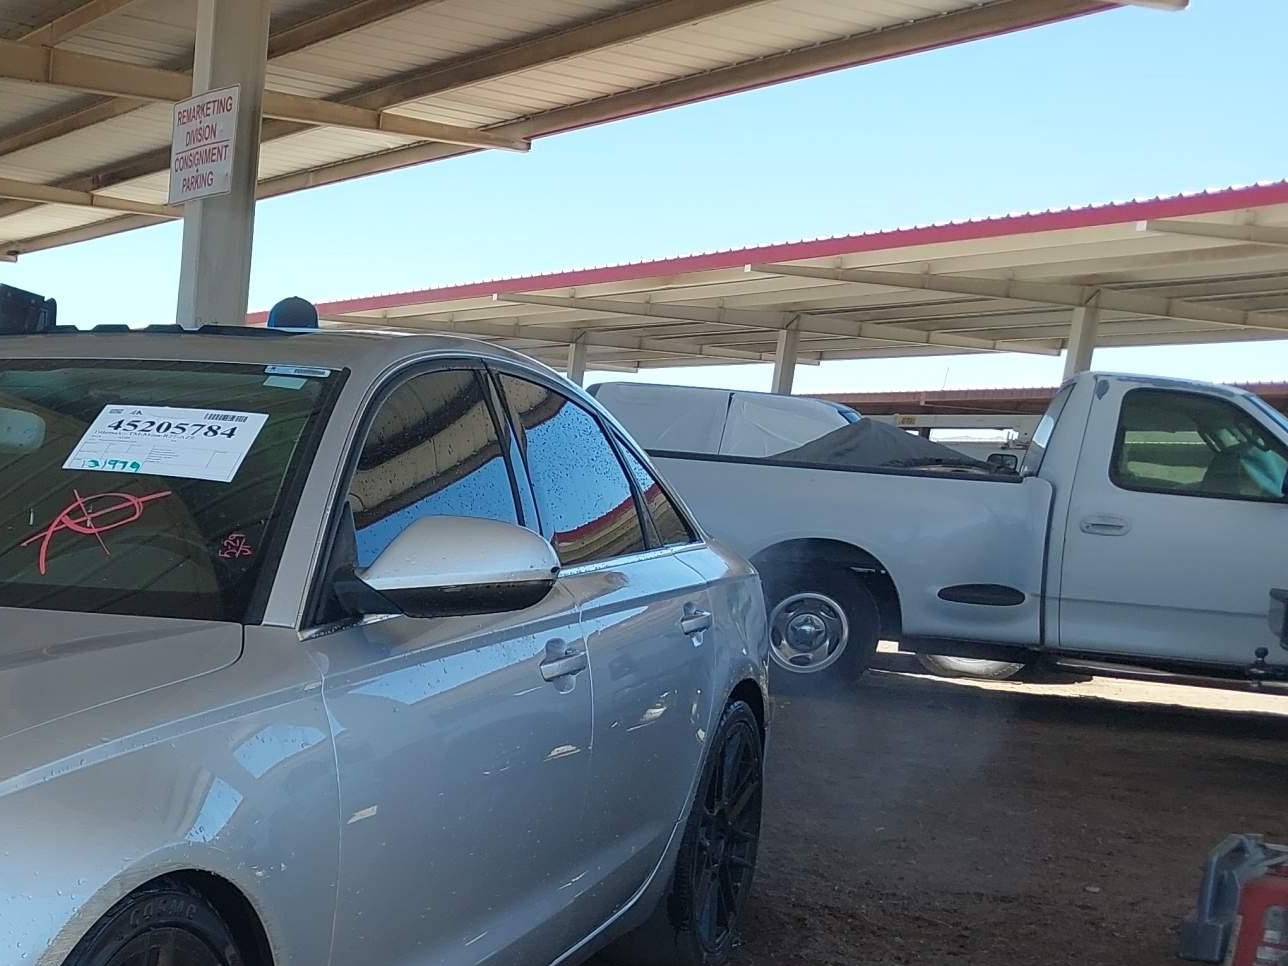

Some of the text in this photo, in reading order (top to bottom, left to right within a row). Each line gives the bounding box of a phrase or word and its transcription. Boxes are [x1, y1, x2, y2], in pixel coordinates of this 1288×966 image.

[177, 96, 233, 126] REMARKETING
[185, 124, 217, 146] DIVISION
[174, 145, 229, 172] CONSIGNMENT
[181, 171, 214, 192] PARKING
[107, 418, 238, 439] 45205784
